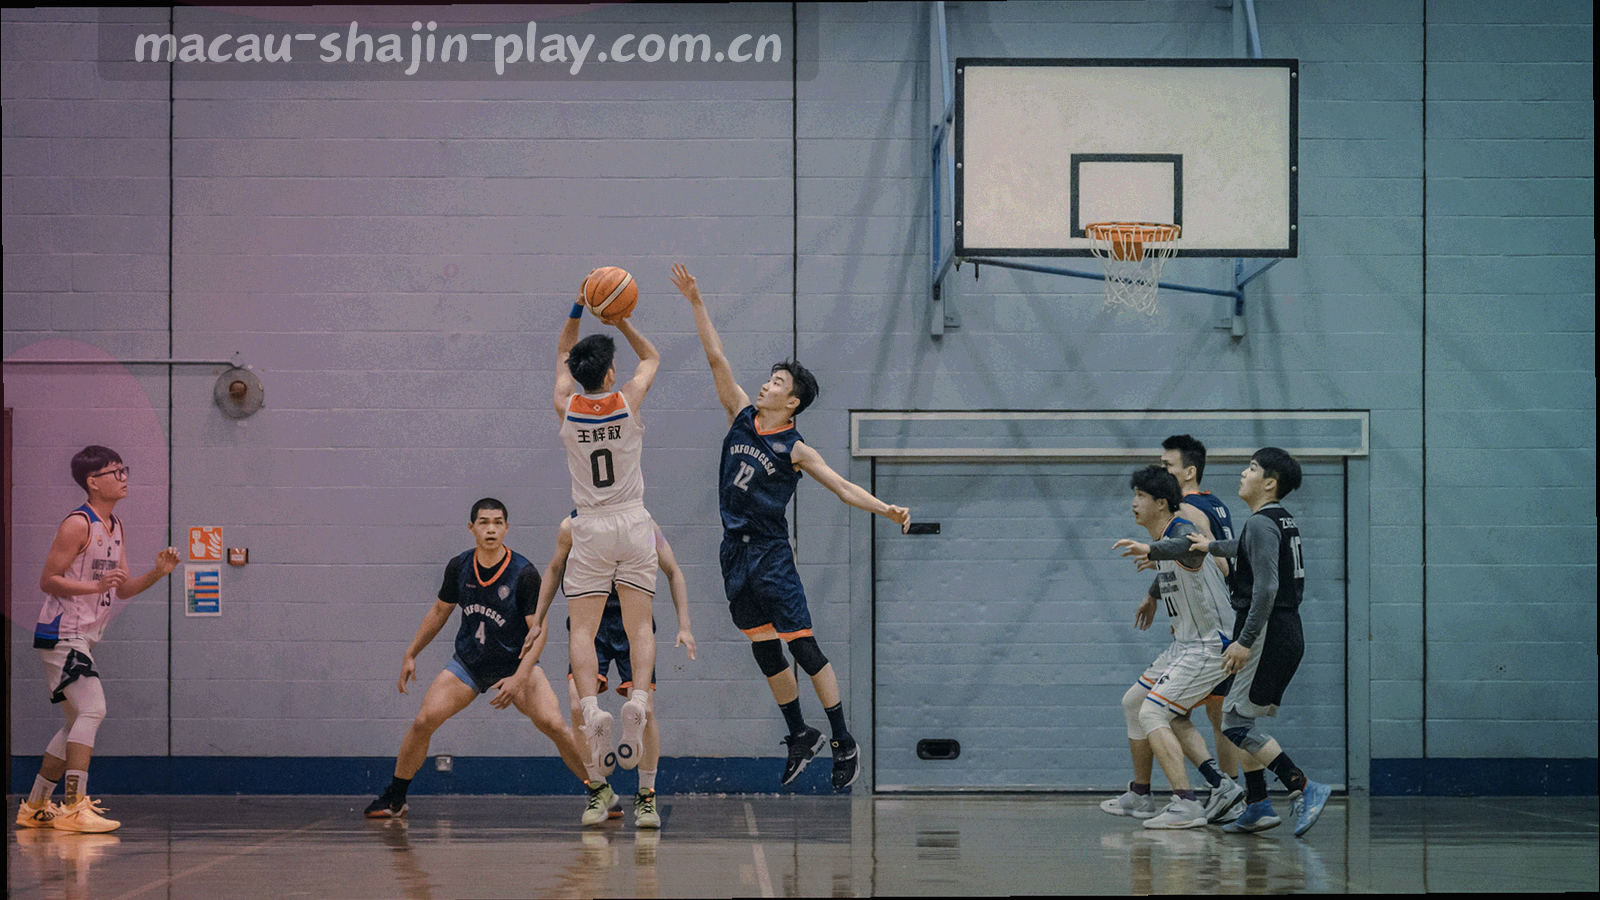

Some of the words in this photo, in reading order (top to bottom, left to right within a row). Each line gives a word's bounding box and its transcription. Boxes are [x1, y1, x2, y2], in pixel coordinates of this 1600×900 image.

[577, 425, 622, 443] 王梓叙
[590, 448, 615, 488] 0
[733, 460, 755, 492] 12
[1165, 596, 1178, 618] 11
[474, 621, 486, 645] 4
